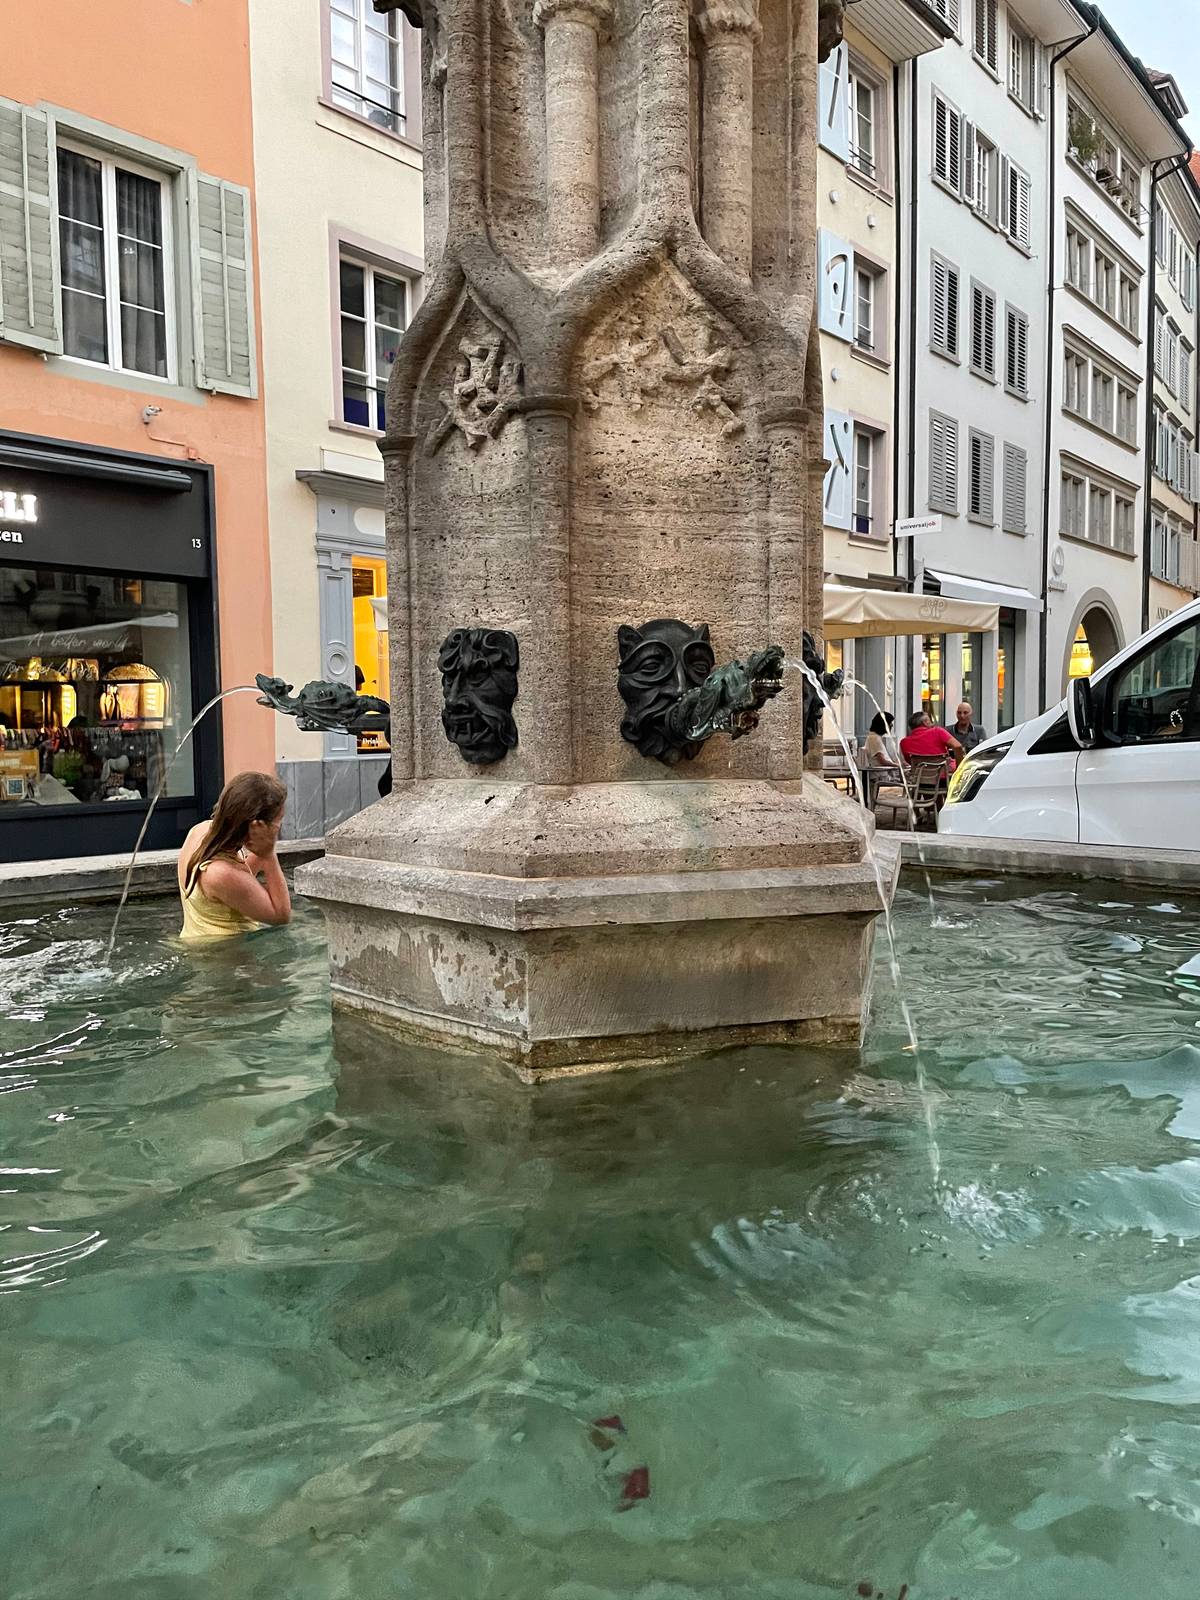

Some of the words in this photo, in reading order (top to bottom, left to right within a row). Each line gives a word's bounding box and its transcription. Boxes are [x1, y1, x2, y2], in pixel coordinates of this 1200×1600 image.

[0, 491, 38, 522] LI
[900, 521, 936, 530] universaljob
[0, 530, 24, 543] en
[191, 538, 202, 549] 13
